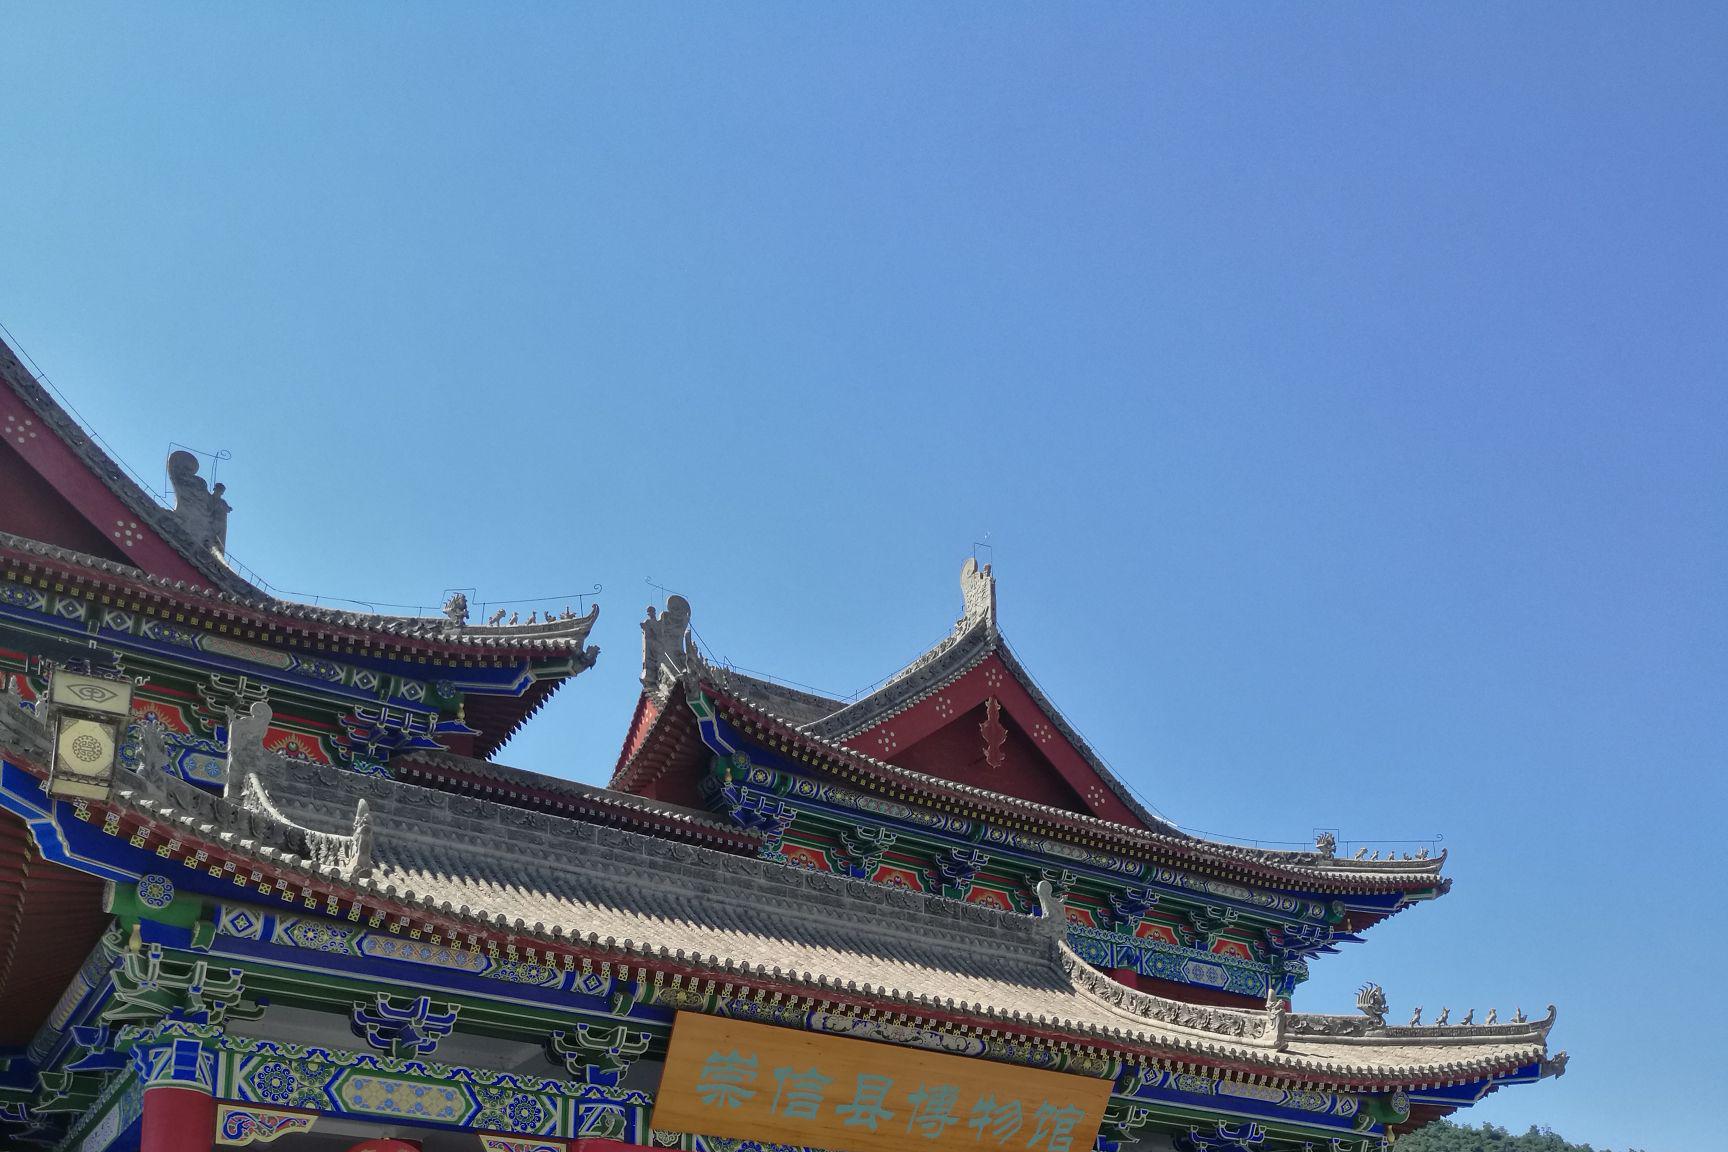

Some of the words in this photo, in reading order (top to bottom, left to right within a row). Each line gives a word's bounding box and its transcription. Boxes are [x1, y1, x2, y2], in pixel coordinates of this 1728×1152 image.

[696, 1050, 1085, 1152] 崇信县博物馆
